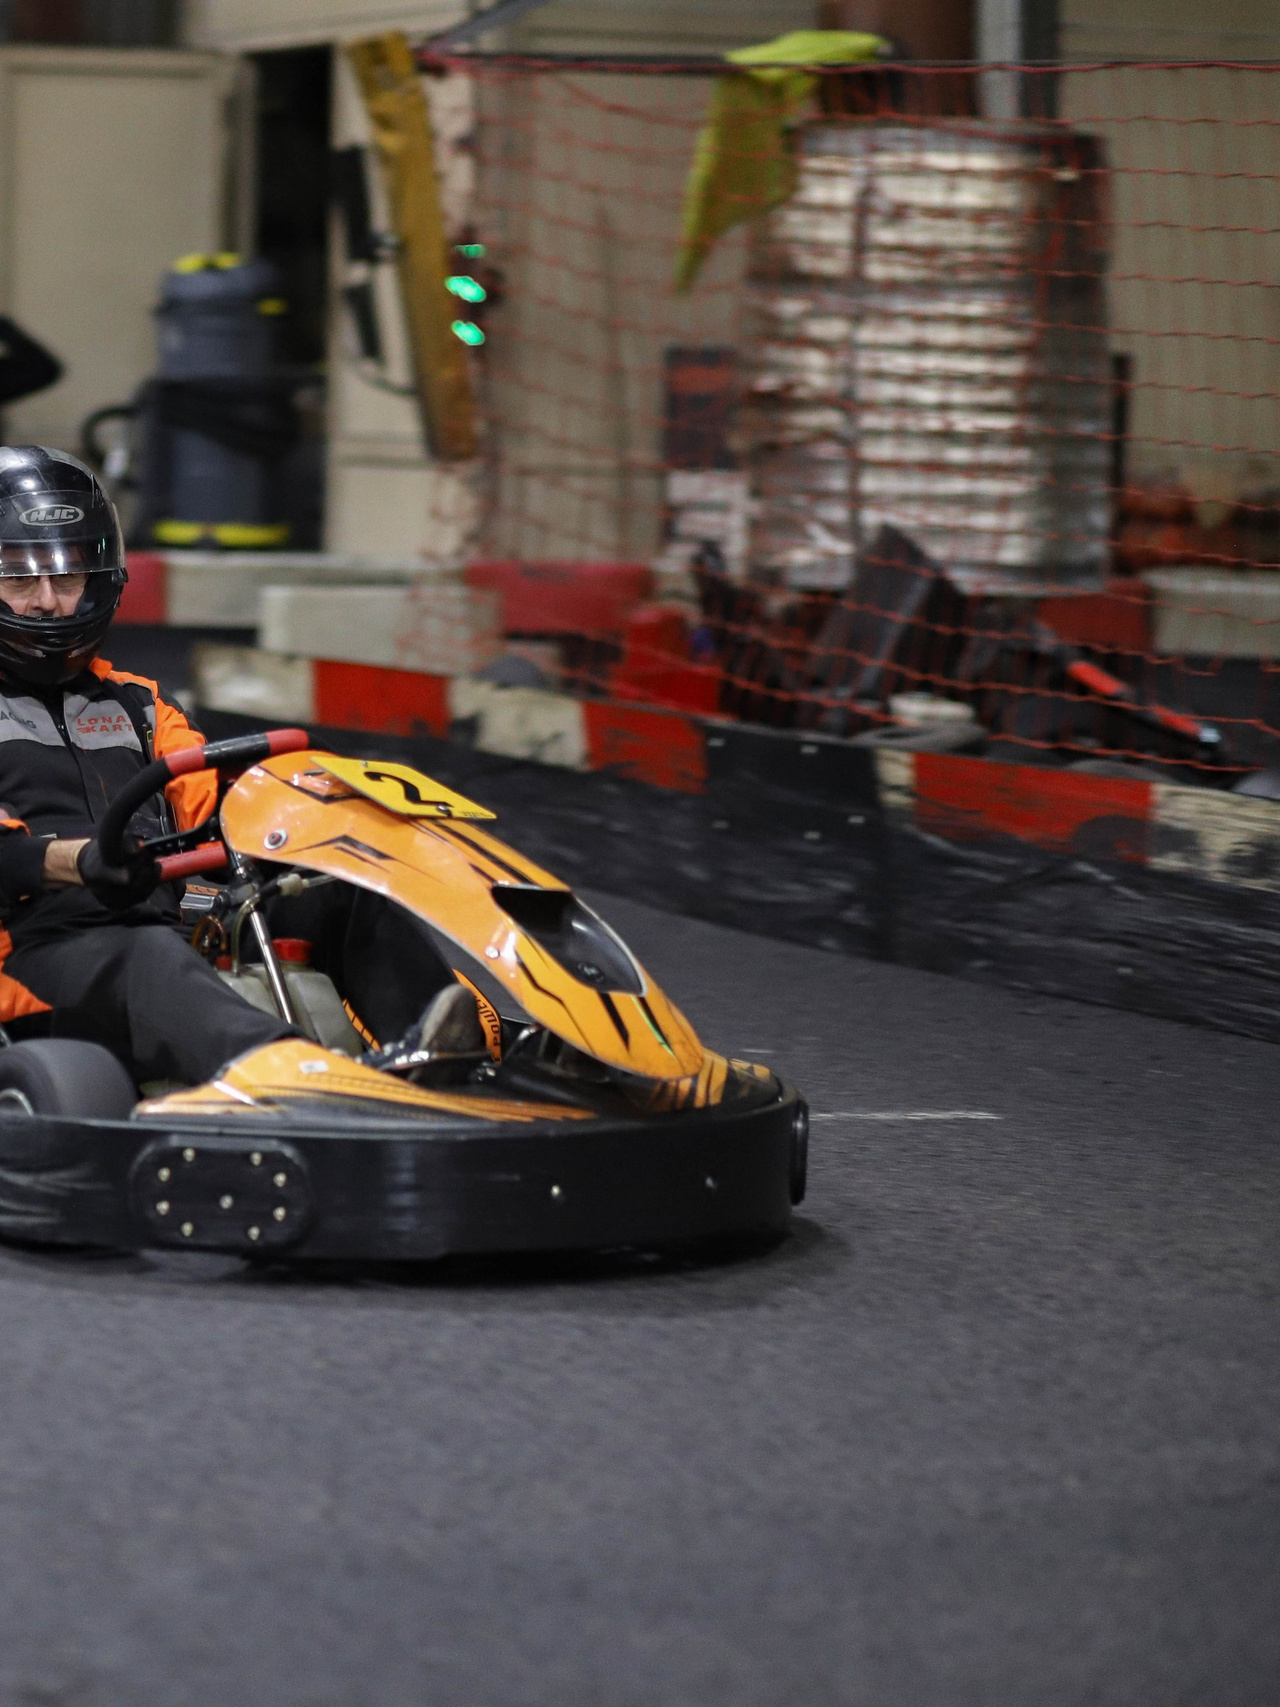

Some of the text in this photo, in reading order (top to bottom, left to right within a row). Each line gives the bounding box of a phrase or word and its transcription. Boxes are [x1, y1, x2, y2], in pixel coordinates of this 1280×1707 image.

[29, 508, 76, 522] HJC
[363, 771, 454, 808] 2
[476, 998, 500, 1047] POWE
